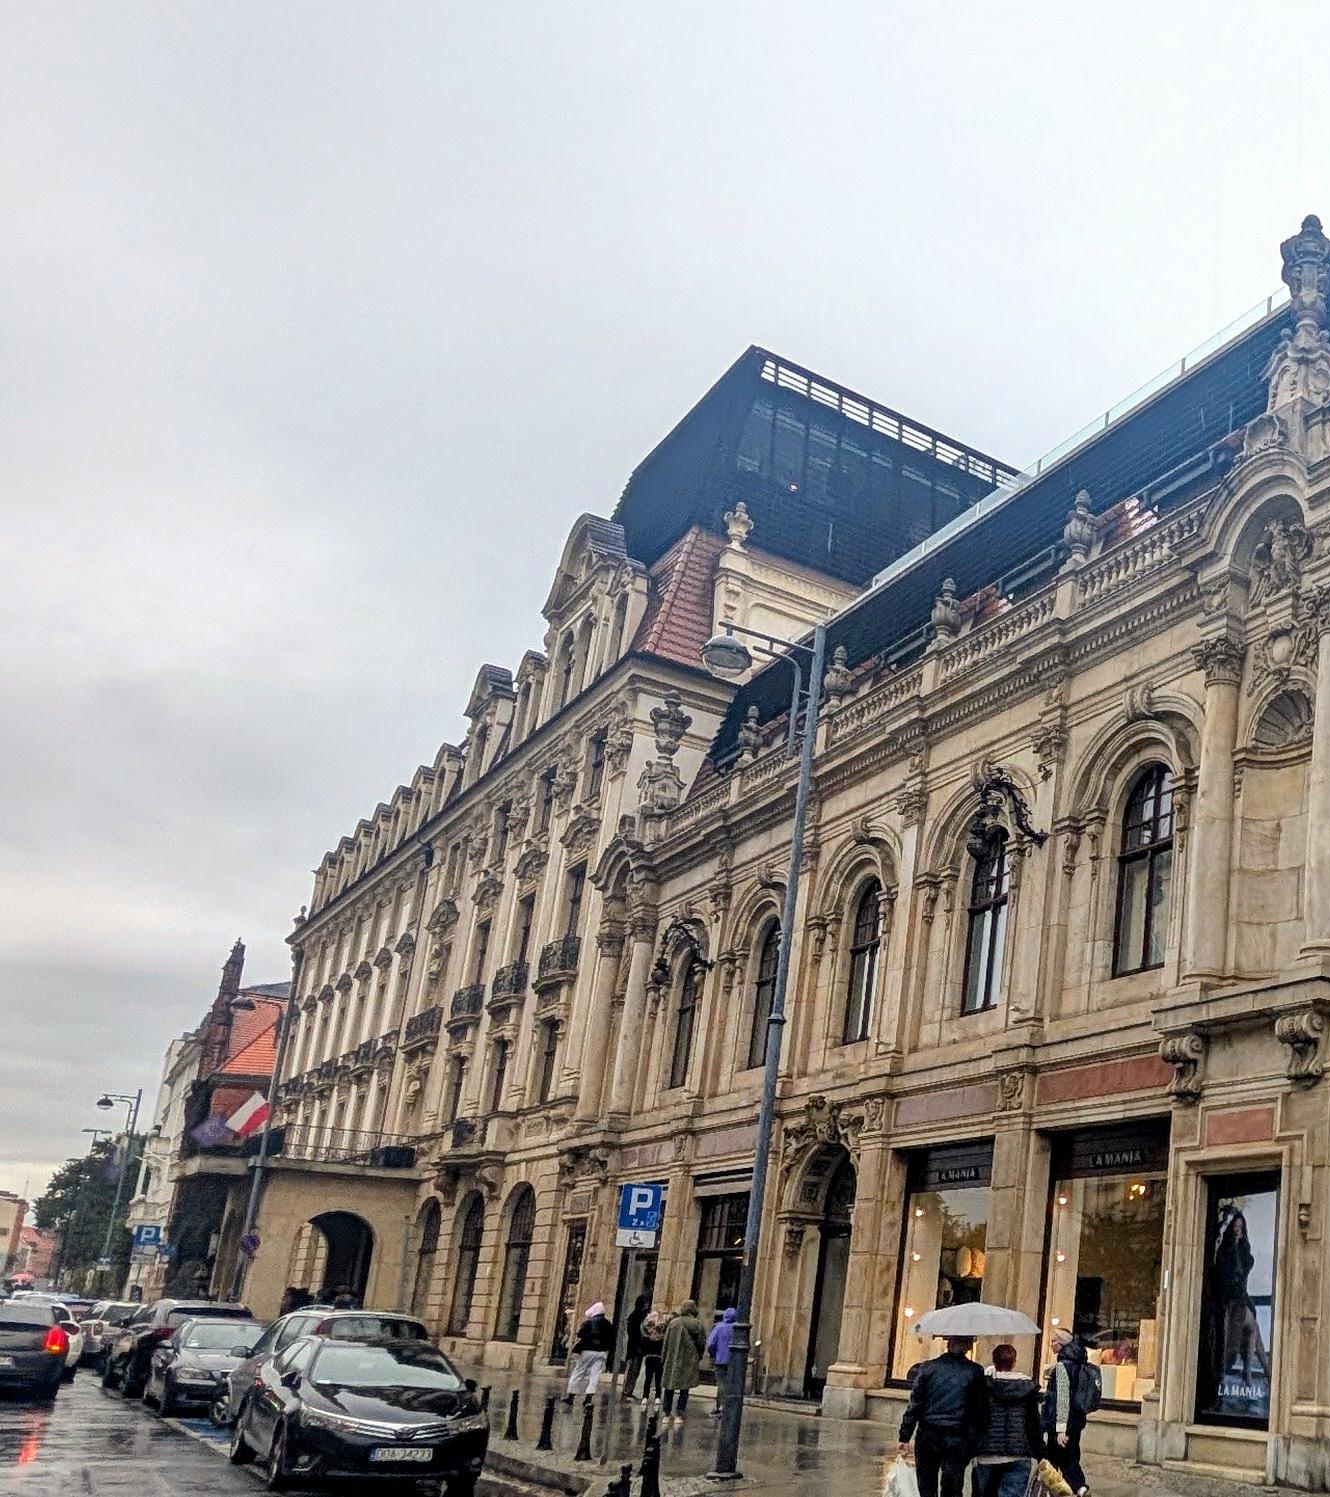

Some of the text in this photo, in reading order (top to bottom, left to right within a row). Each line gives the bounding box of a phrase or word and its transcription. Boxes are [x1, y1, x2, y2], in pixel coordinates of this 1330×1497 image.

[1105, 1149, 1142, 1166] MANIA
[628, 1187, 654, 1216] P
[1217, 1383, 1264, 1399] LA MANIA
